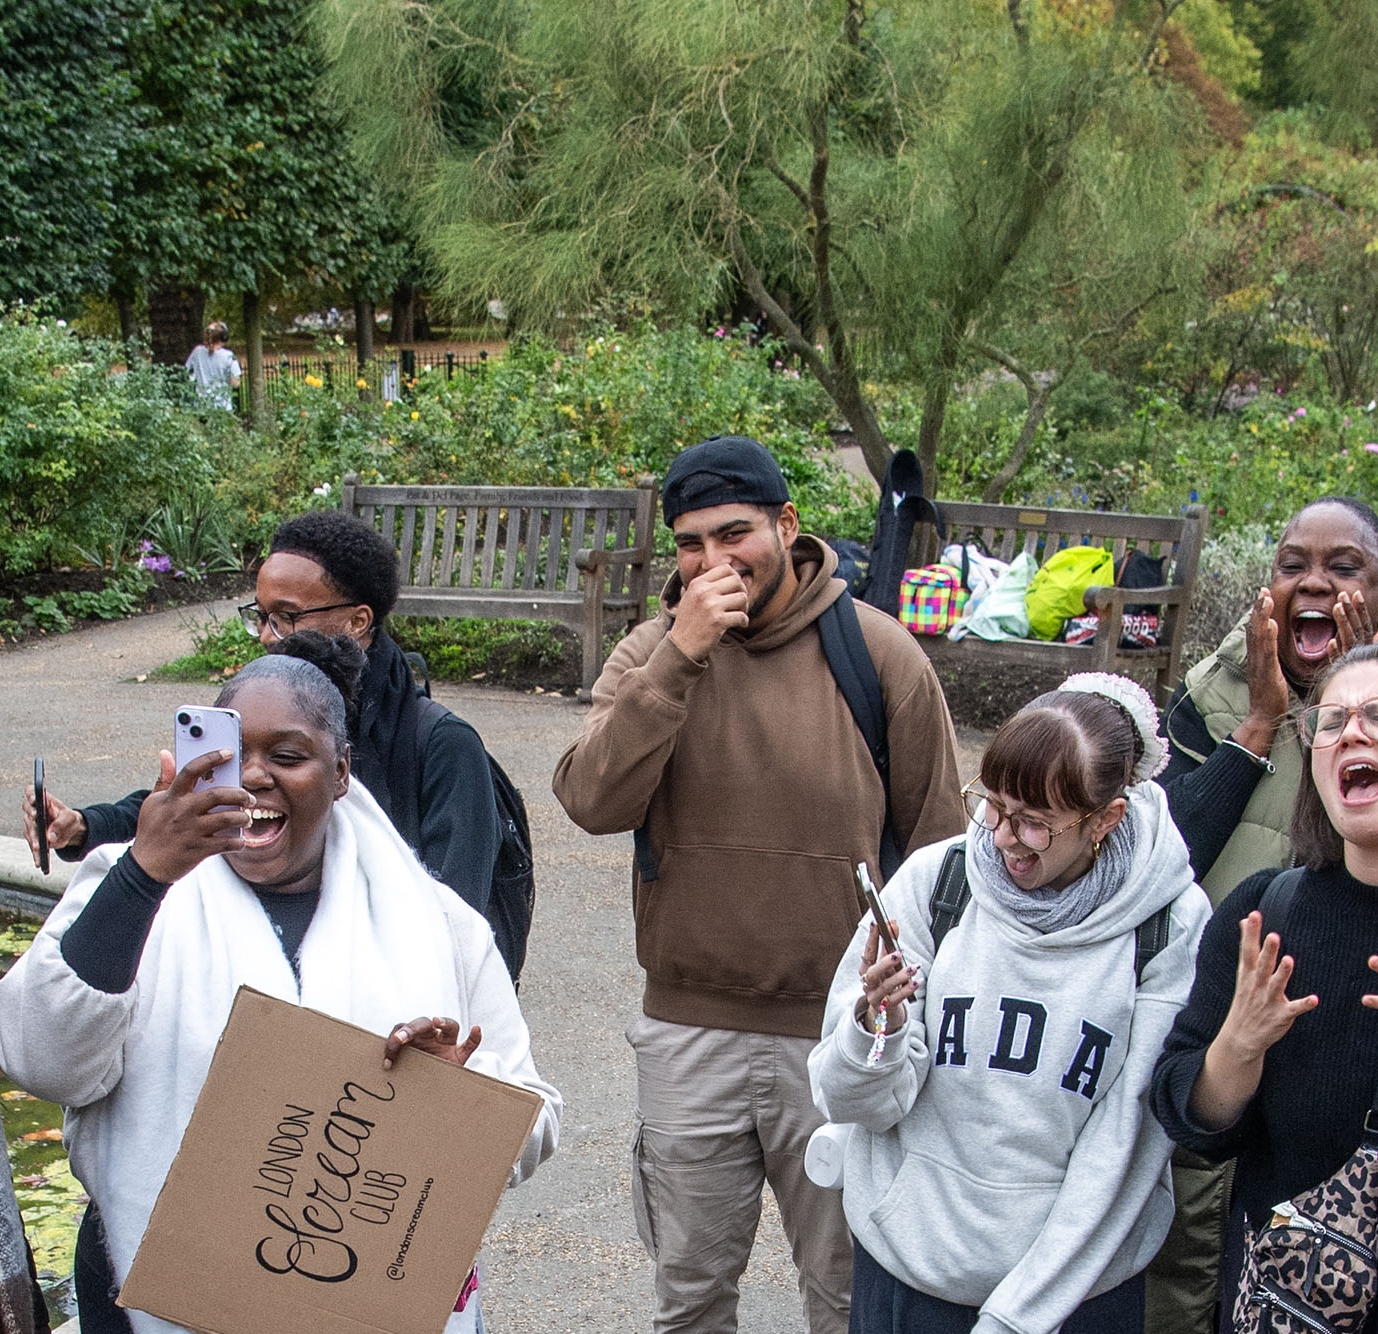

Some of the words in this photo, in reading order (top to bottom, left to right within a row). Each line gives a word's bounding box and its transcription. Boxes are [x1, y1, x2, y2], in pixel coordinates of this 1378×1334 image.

[541, 491, 558, 502] and
[253, 1104, 315, 1198] LONDON
[255, 1080, 397, 1284] Scream
[350, 1170, 407, 1225] CLUB
[386, 1177, 434, 1280] @londonscreamclub
